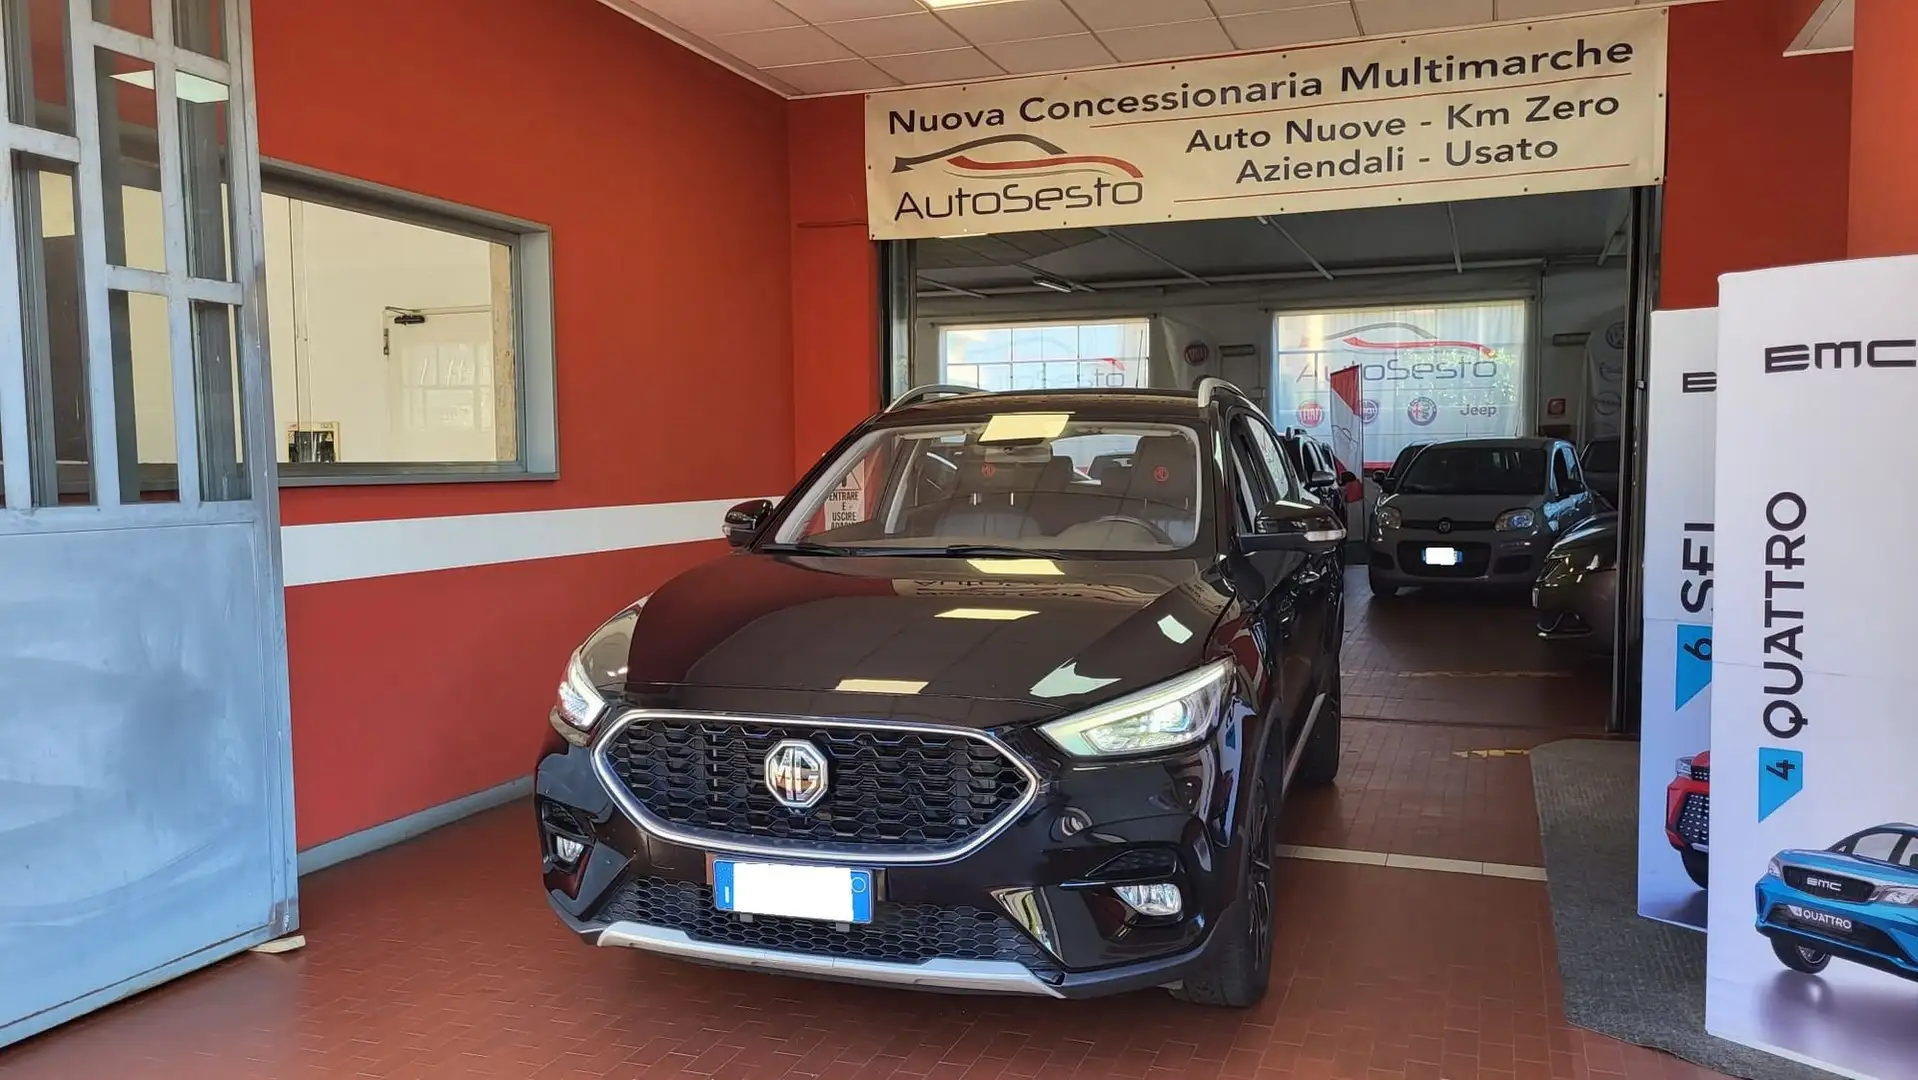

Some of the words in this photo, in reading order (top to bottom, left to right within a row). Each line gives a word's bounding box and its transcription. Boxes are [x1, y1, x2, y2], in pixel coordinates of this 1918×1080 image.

[889, 107, 1004, 135] Nuova
[1019, 72, 1322, 123] Concessionaria
[1341, 38, 1634, 92] Multimarche
[1186, 127, 1271, 154] Auto
[1286, 113, 1406, 145] Nuove
[1447, 102, 1510, 130] Km
[1525, 93, 1620, 123] Zero
[1235, 145, 1404, 184] Aziendali
[1445, 137, 1558, 167] Usato
[894, 176, 1144, 221] AutoSesto
[1764, 339, 1917, 374] EMC
[1459, 404, 1498, 418] Jeep
[829, 491, 859, 501] ENTRARE
[842, 501, 847, 511] E
[832, 511, 857, 521] USCIRE
[1762, 491, 1808, 739] QUATTRO
[1683, 637, 1713, 662] 6
[769, 744, 821, 802] MG
[1766, 758, 1796, 781] 4
[1806, 876, 1842, 892] EMC
[1802, 908, 1852, 930] QUATTRO
